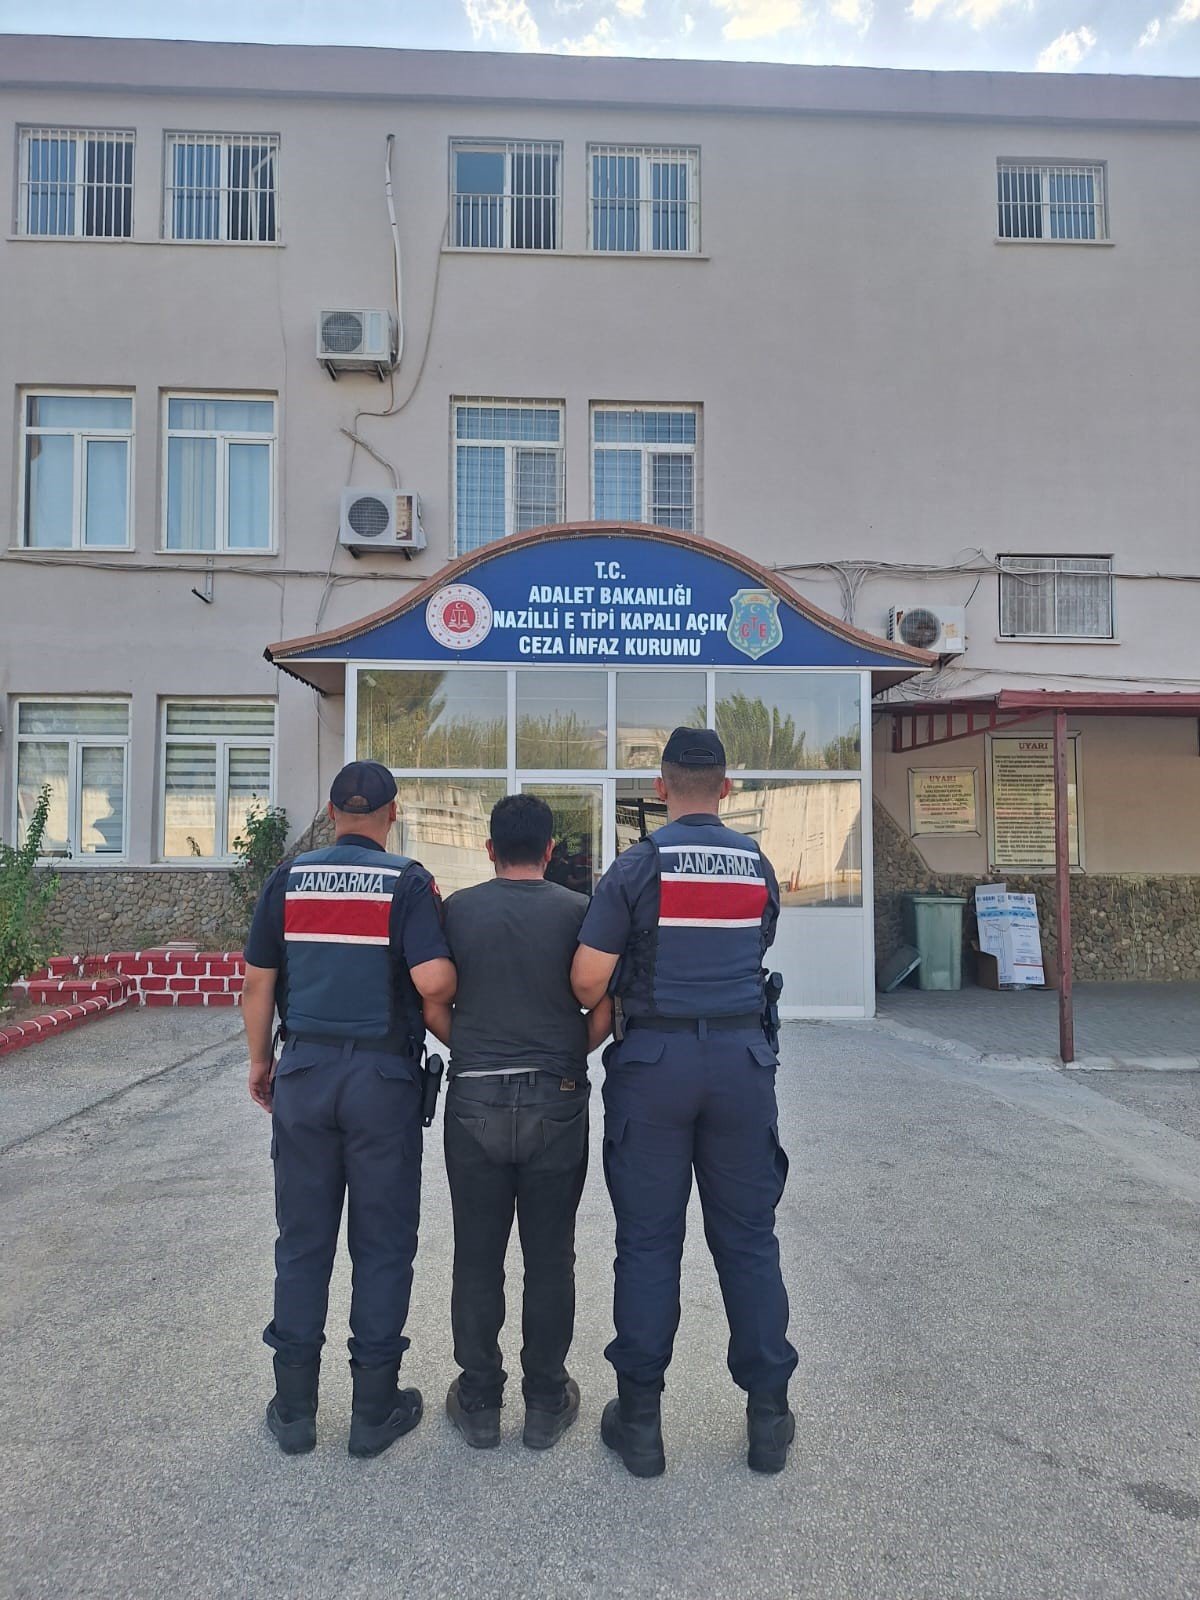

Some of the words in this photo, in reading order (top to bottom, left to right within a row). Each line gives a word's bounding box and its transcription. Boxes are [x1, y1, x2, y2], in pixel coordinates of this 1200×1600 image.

[594, 561, 626, 580] T.C.
[528, 586, 595, 604] ADALET
[600, 584, 691, 605] BAKANLIĞI
[493, 608, 559, 629] NAZİLLİ
[564, 612, 575, 629] E
[580, 608, 614, 630] TİPİ
[620, 613, 681, 631] KAPALI
[685, 613, 728, 635] AÇIK
[519, 637, 564, 654] CEZA
[569, 634, 619, 655] İNFAZ
[625, 638, 702, 657] KURUMU
[1018, 742, 1049, 750] UYARI
[673, 852, 758, 878] JANDARMA
[295, 872, 384, 893] JANDARMA
